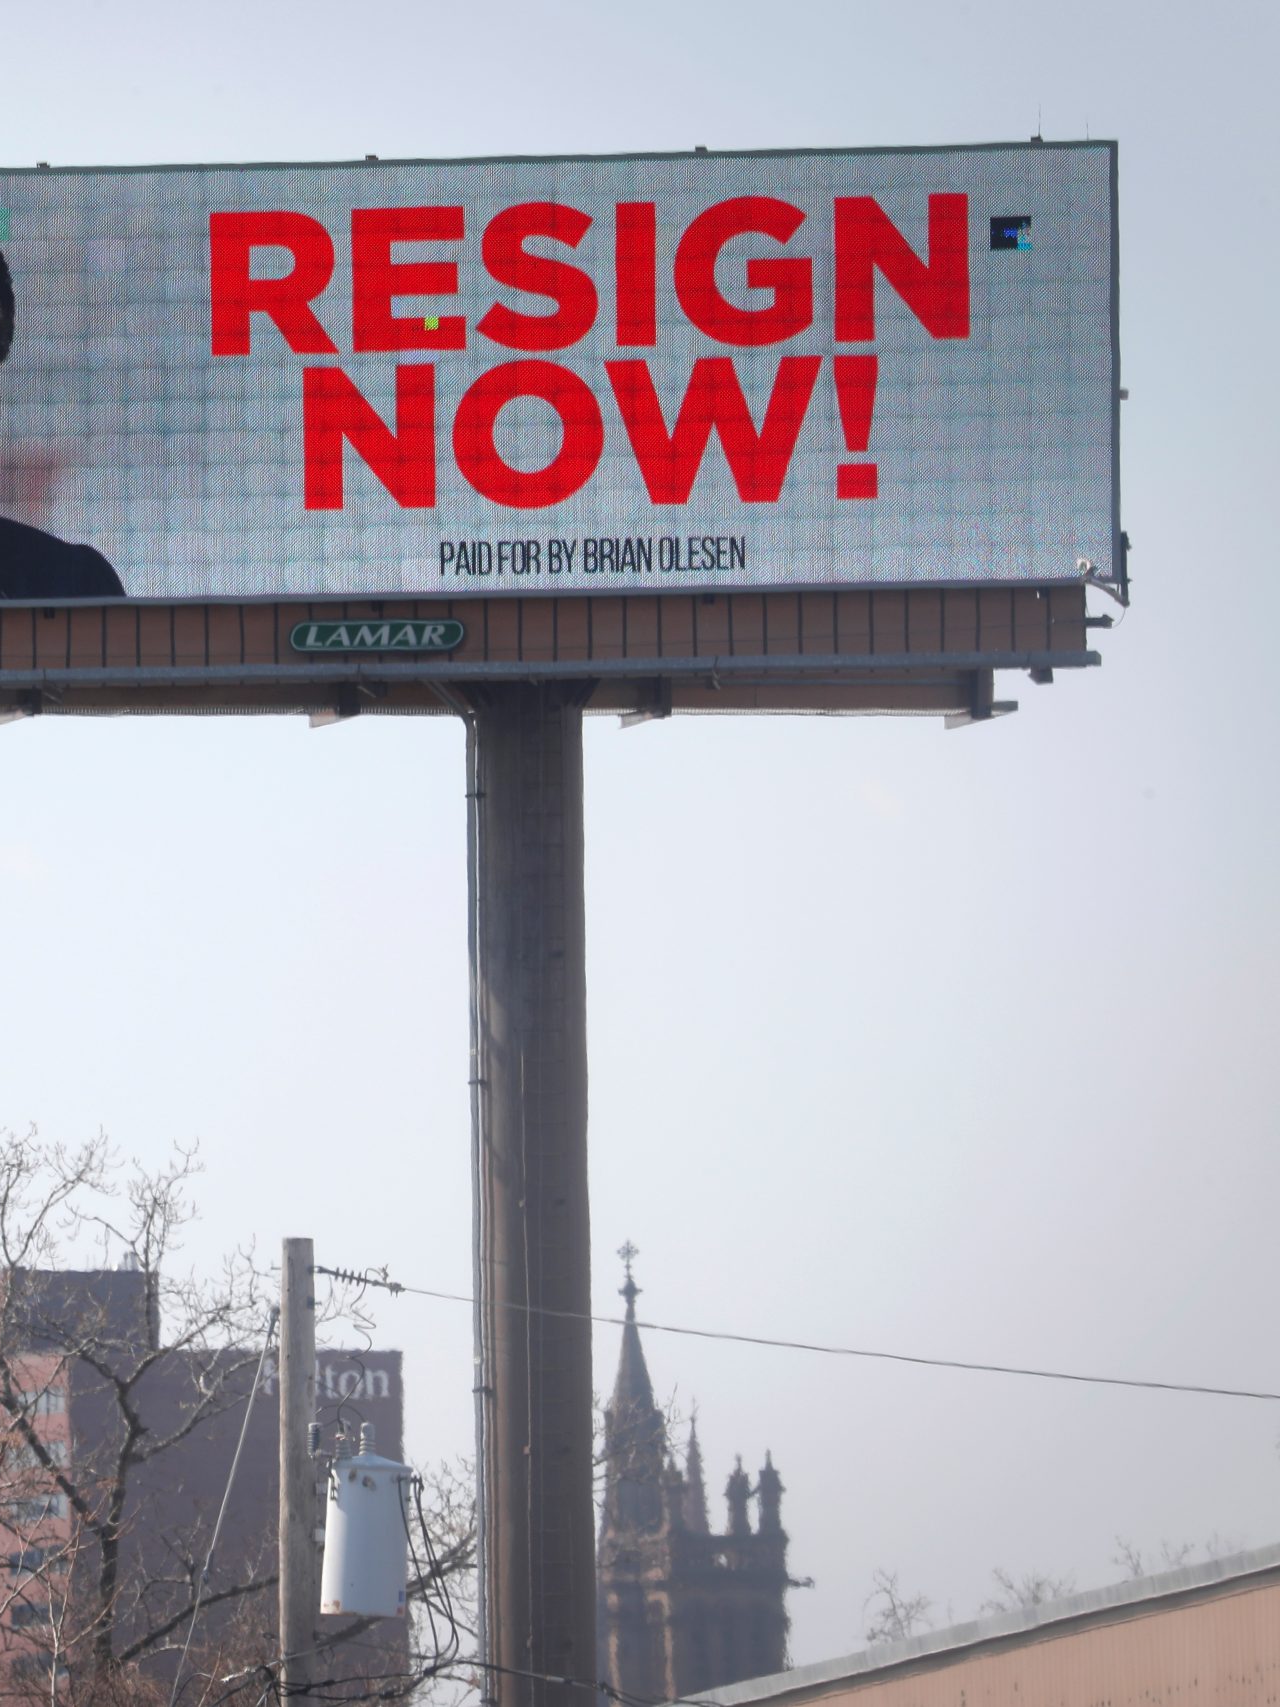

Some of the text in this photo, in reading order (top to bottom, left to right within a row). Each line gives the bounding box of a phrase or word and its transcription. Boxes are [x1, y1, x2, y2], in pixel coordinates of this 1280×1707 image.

[209, 193, 970, 356] RESIGN
[302, 355, 878, 512] NOW!
[440, 535, 746, 576] PAID FOR BY BRIAN OLESEN
[304, 623, 447, 648] LAMAR
